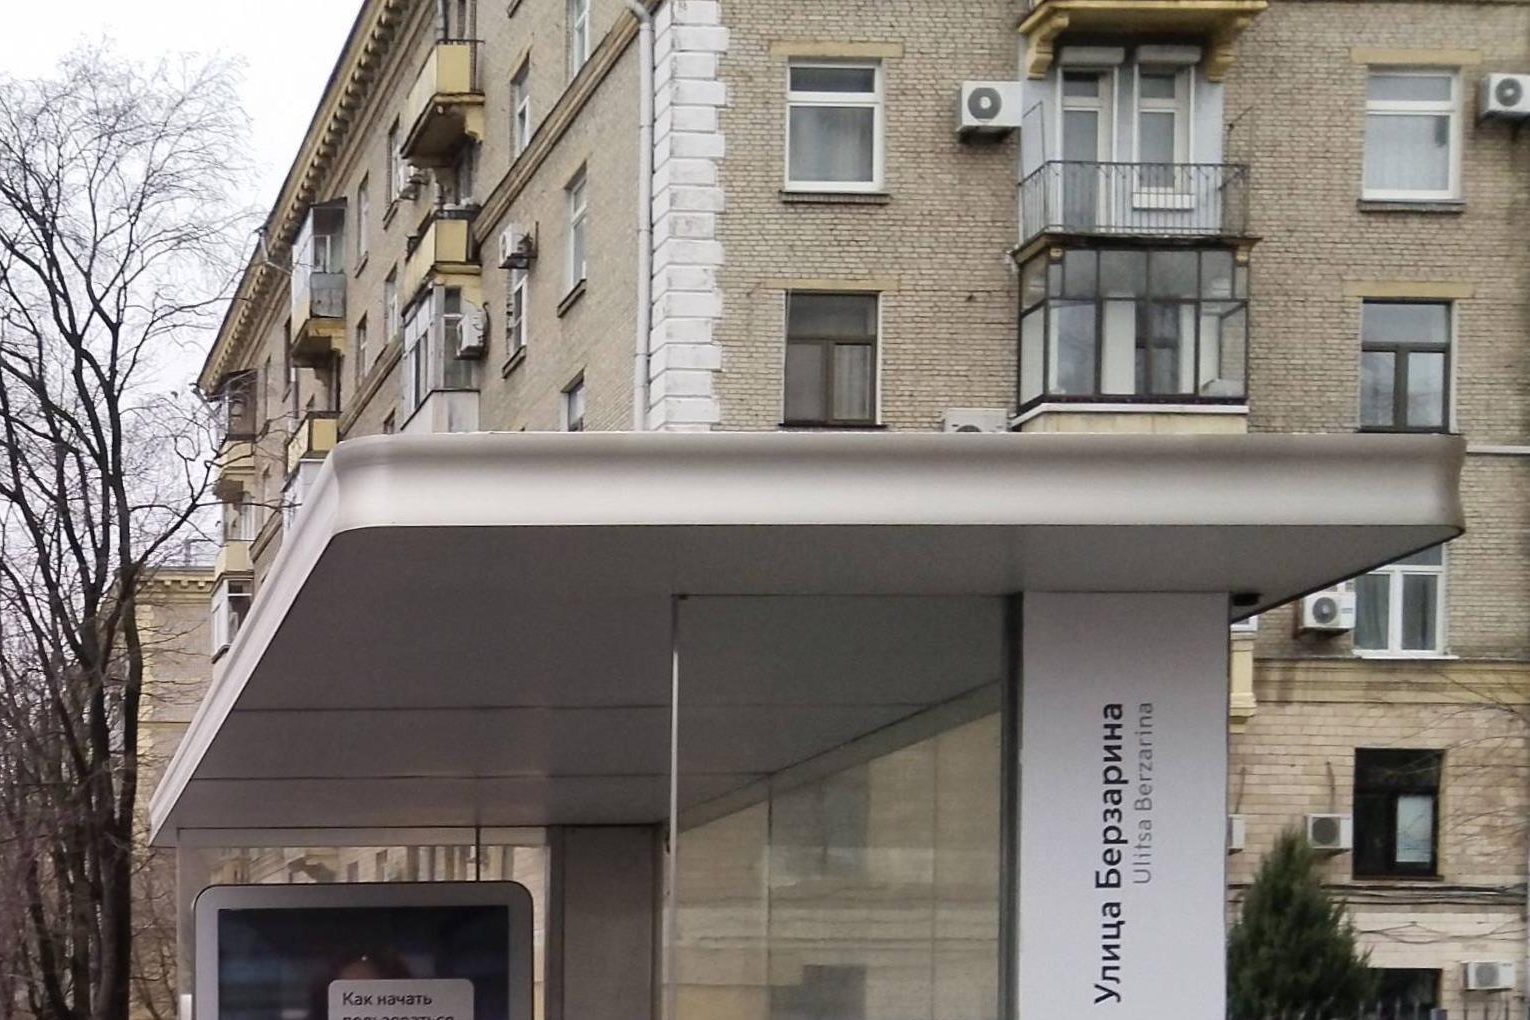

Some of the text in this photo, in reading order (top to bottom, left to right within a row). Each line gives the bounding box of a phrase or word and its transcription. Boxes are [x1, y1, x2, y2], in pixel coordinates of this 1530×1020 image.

[1094, 703, 1129, 1004] Улица Берзарина
[1132, 702, 1154, 884] Ulitsa Berzarina
[342, 991, 433, 1007] Как начать
